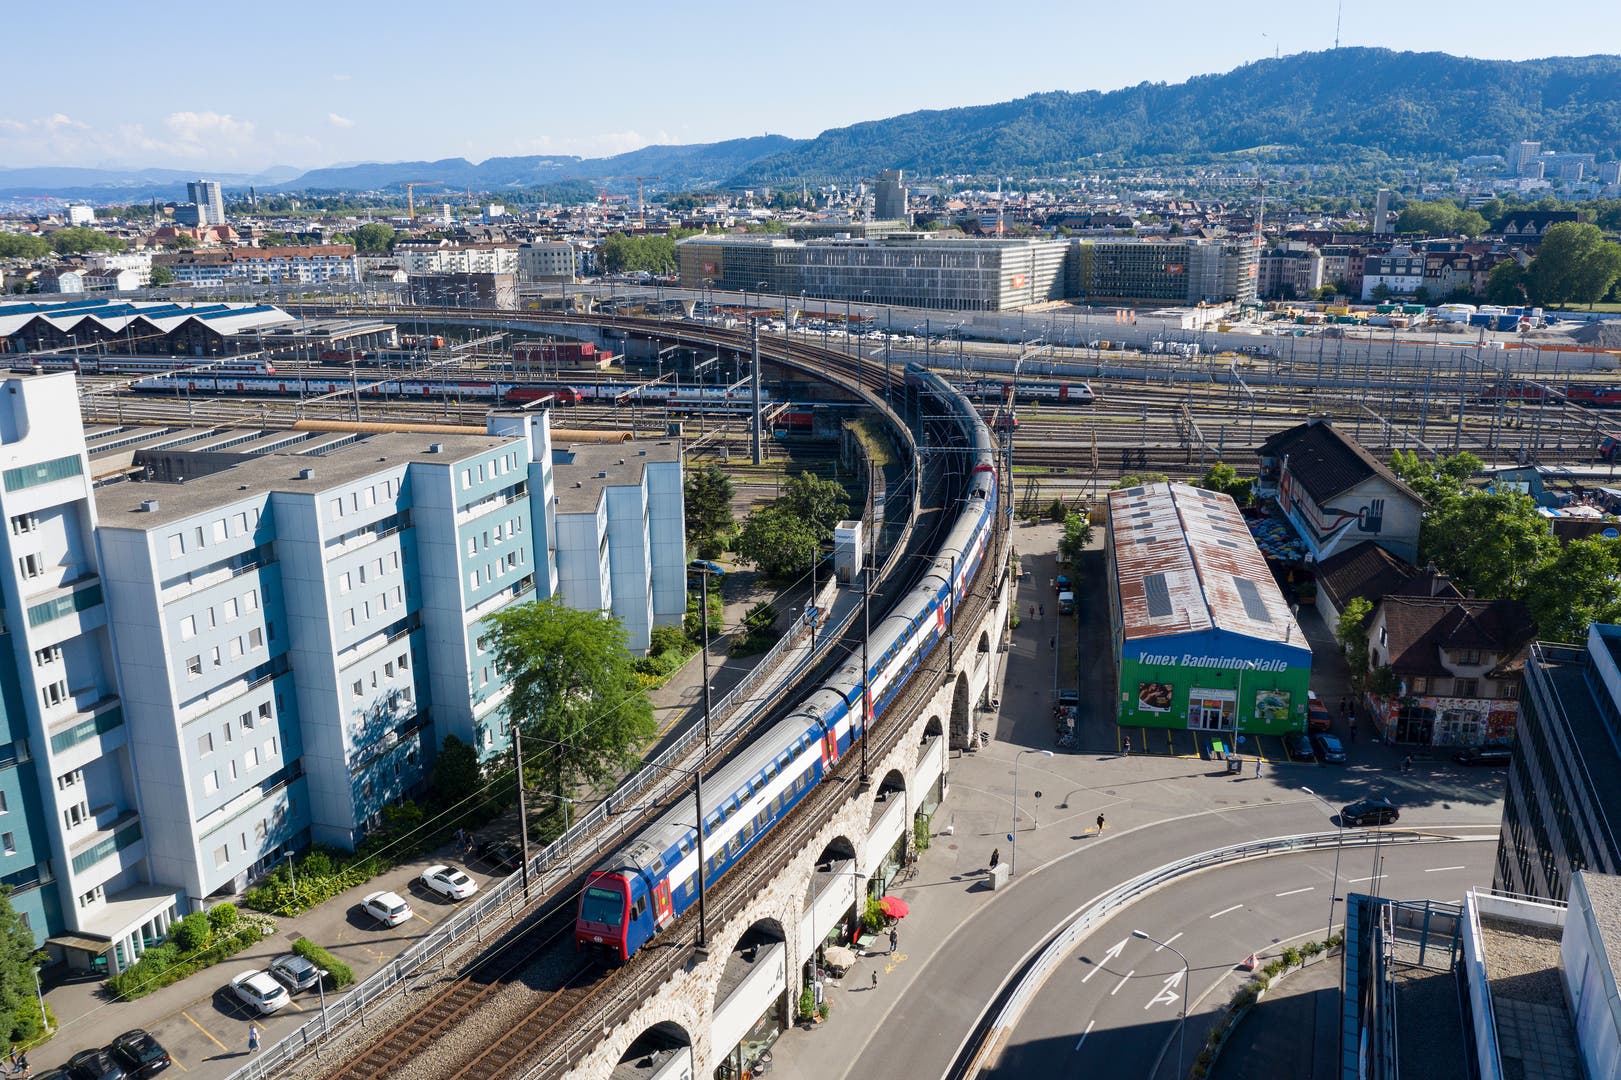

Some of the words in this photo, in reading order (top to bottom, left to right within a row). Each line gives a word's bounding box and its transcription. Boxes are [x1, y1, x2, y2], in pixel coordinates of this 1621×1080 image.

[1138, 651, 1178, 666] Yonex
[1180, 653, 1250, 670] Badminton
[1253, 658, 1288, 673] Halle
[775, 961, 783, 981] 4
